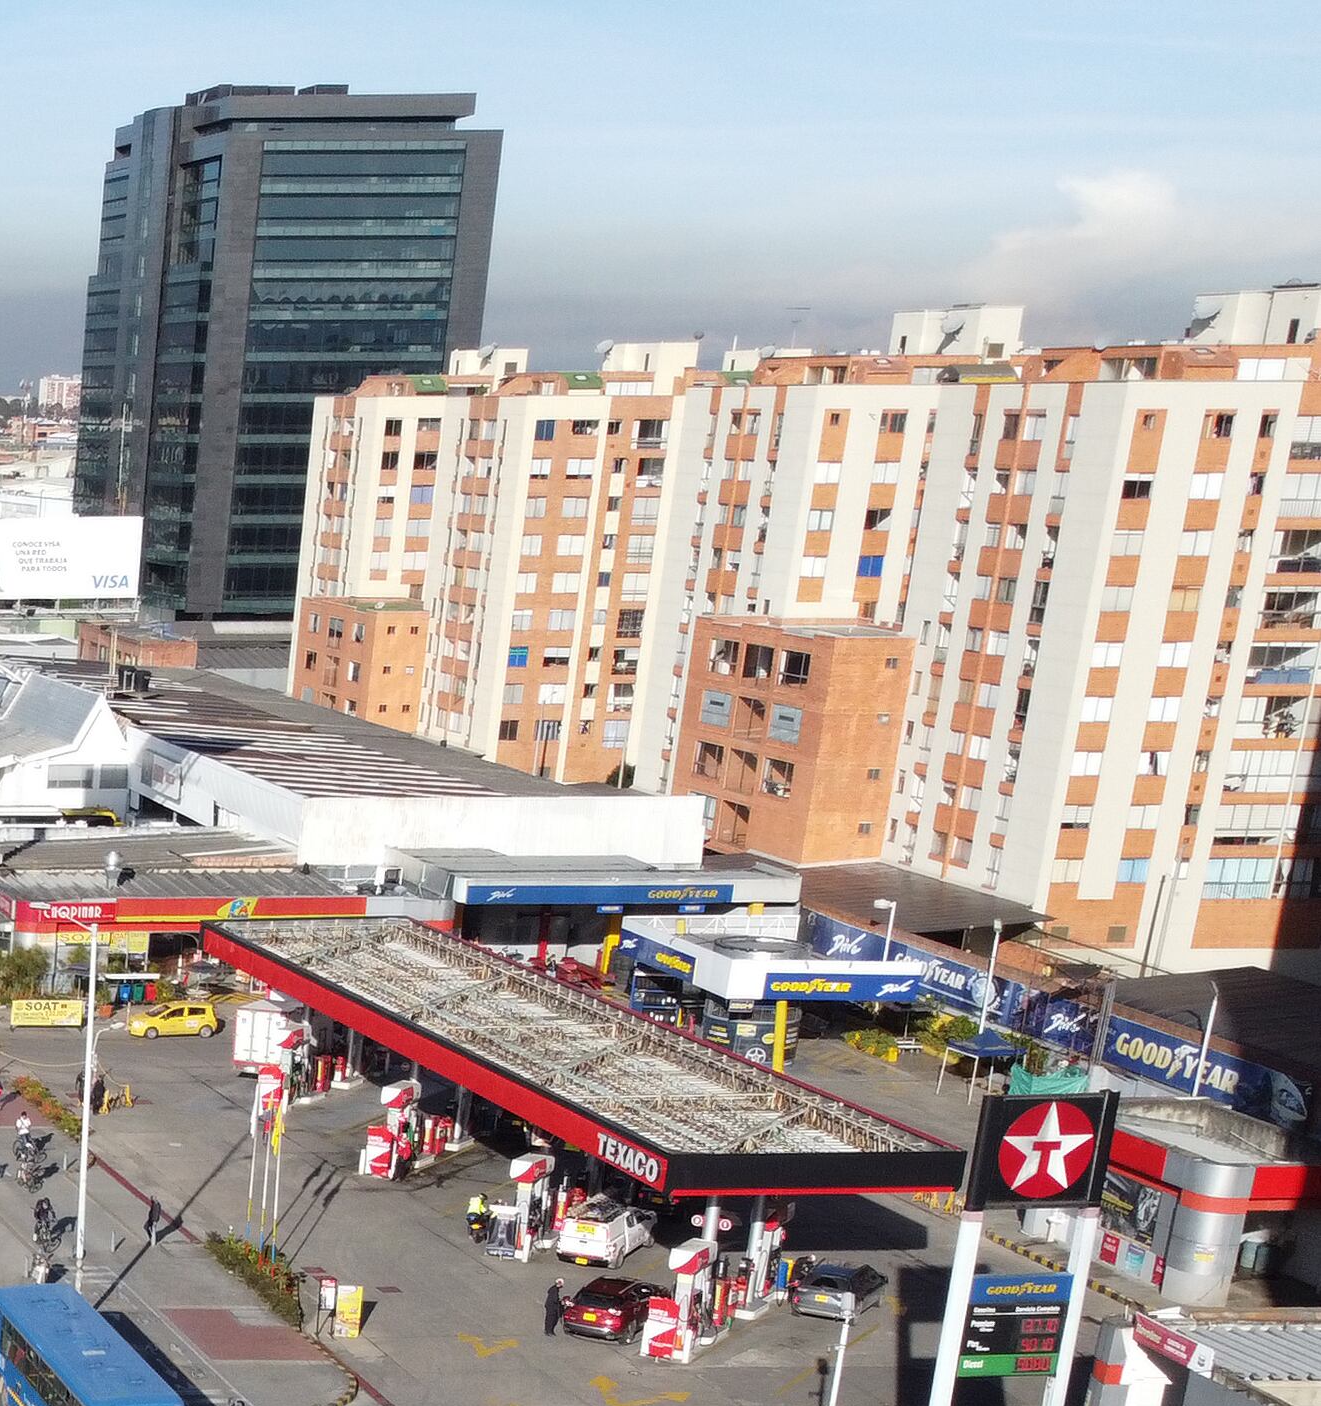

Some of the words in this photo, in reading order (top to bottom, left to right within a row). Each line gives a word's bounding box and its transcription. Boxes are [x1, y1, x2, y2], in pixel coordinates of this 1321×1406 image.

[92, 575, 129, 589] VISA
[770, 978, 852, 994] GOODYEAR
[25, 1001, 60, 1011] SOAT
[1116, 1032, 1239, 1095] GOODYEAR
[597, 1132, 658, 1183] TEXACO
[986, 1282, 1057, 1296] GOODYEAR
